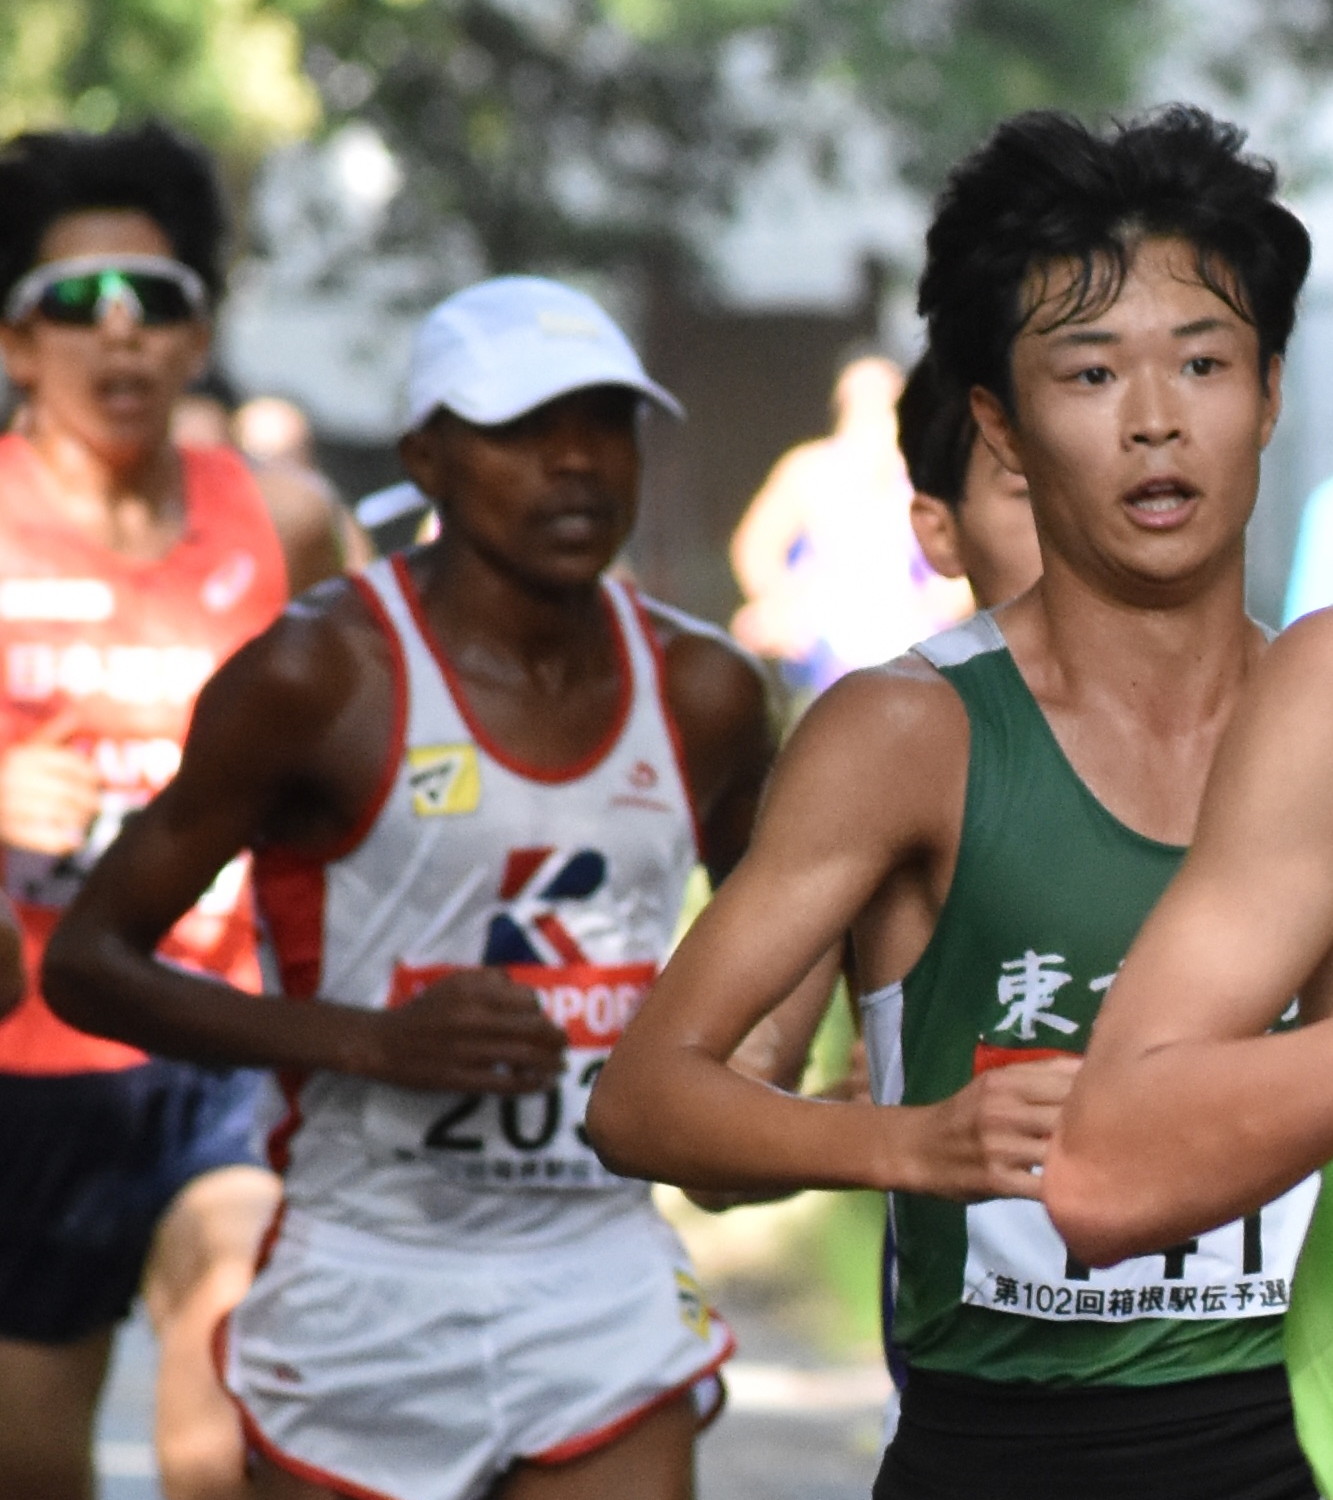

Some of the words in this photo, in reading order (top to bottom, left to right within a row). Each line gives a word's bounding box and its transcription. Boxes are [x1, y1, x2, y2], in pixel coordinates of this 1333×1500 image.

[426, 1058, 606, 1150] 20
[992, 1274, 1290, 1316] 第102回箱根駅伝予選
